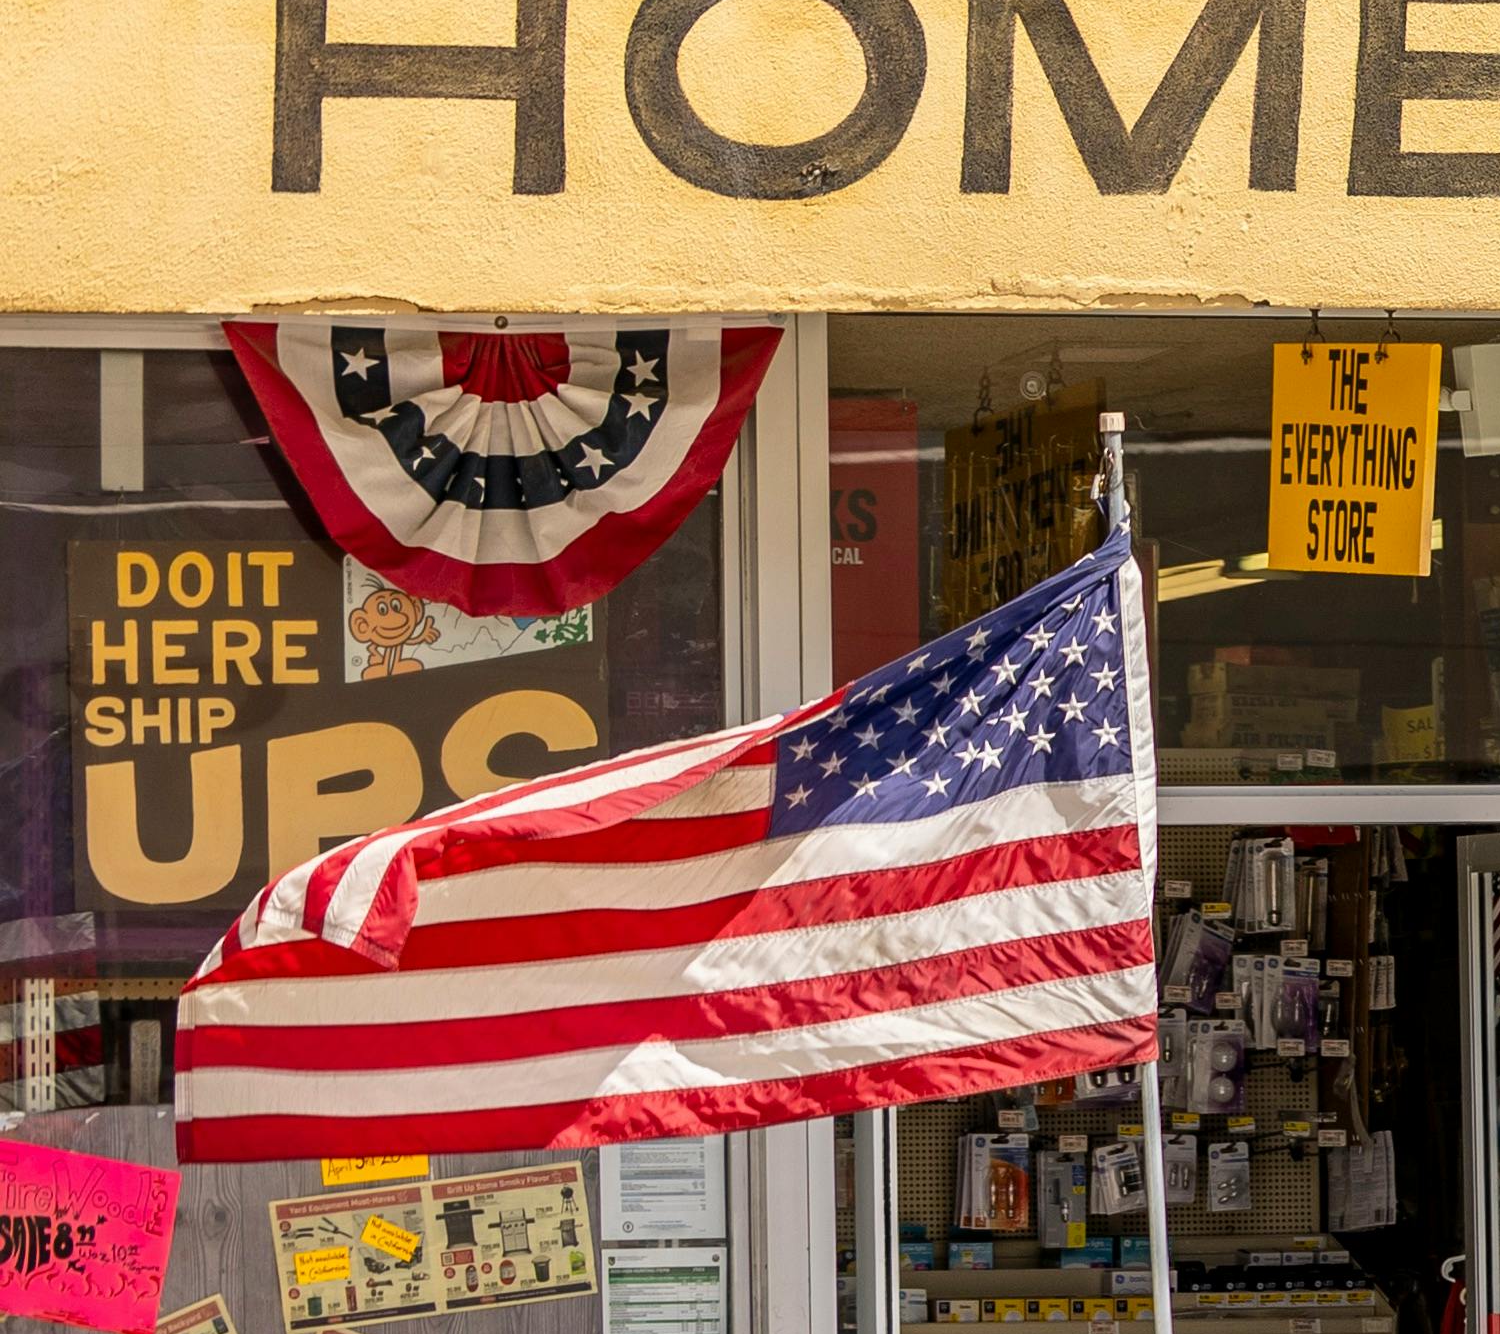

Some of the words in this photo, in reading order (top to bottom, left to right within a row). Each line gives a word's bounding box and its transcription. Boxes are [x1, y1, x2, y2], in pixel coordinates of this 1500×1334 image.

[1328, 348, 1370, 416] THE
[1279, 421, 1418, 492] EVERYTHING
[1307, 501, 1377, 567] STORE
[91, 619, 320, 686] HERE
[84, 697, 236, 747] SHIP
[1406, 716, 1434, 734] SAL
